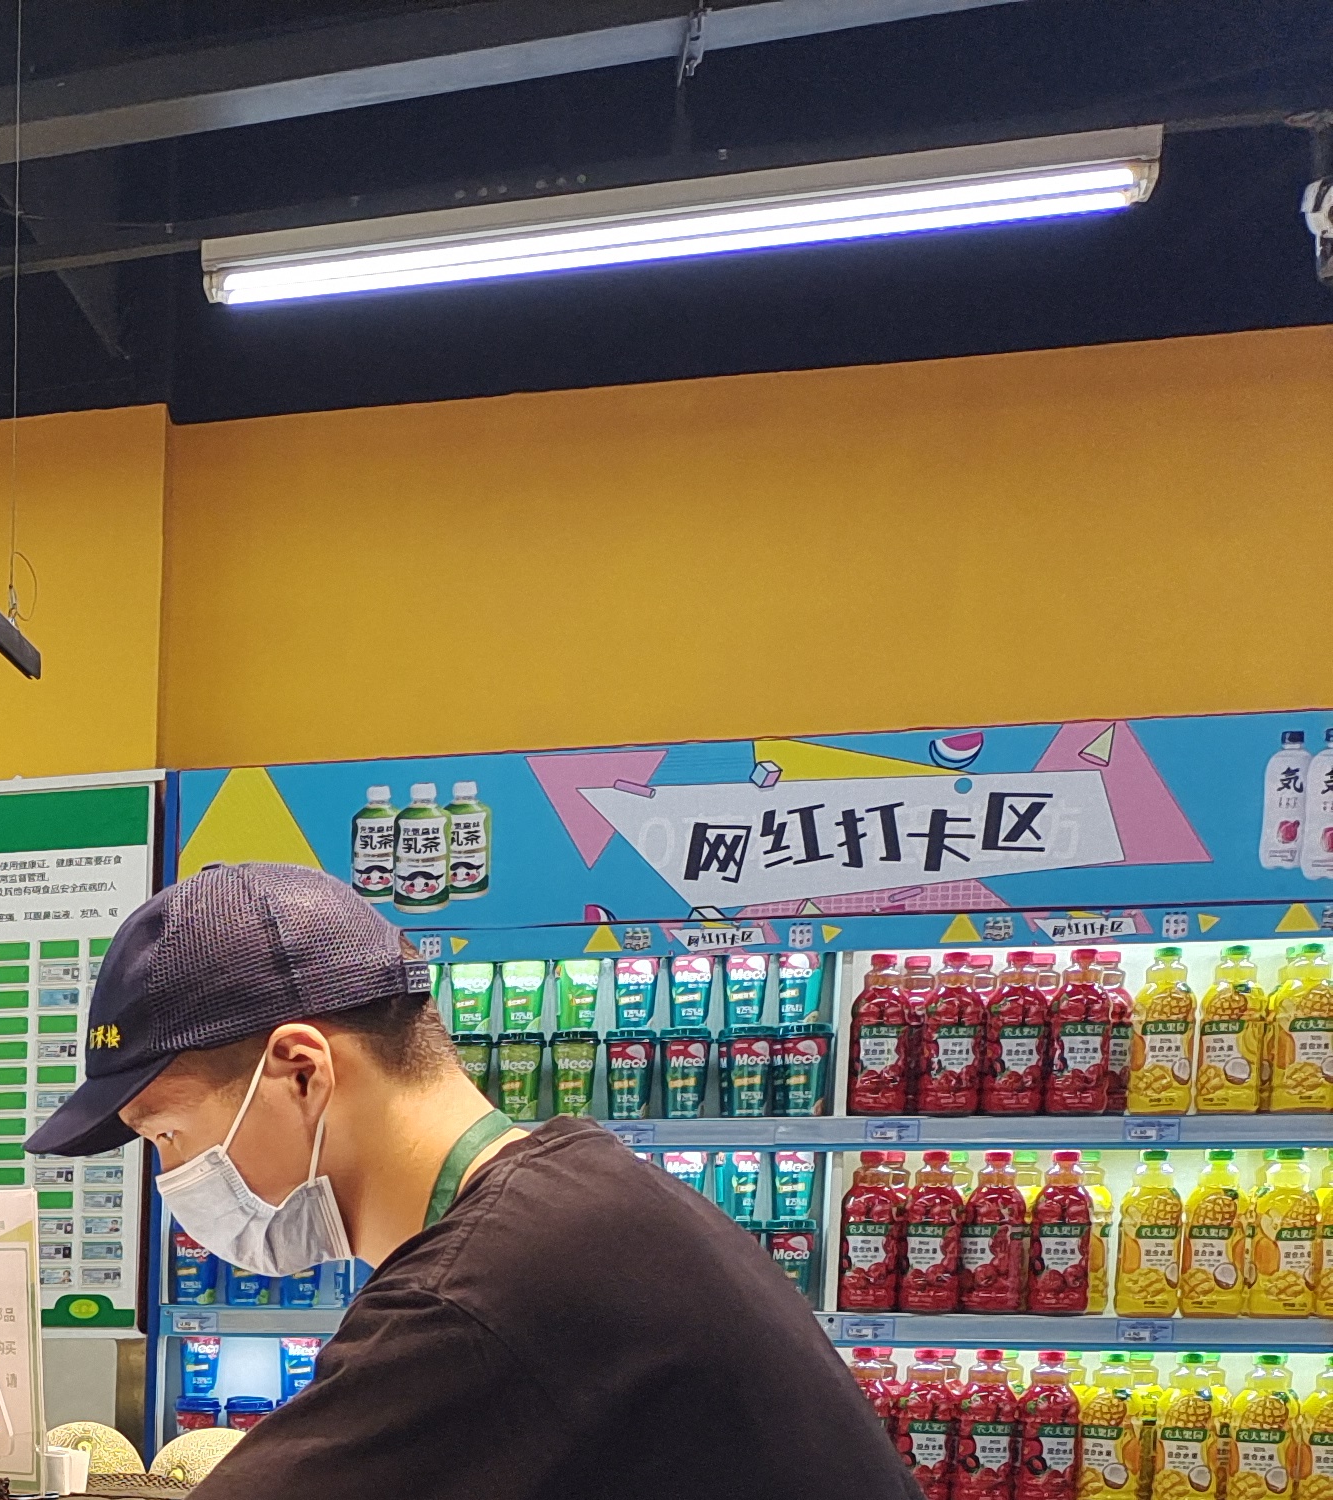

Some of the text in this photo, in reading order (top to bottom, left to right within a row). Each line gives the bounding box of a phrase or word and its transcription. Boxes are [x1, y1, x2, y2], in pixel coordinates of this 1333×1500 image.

[402, 837, 441, 854] 乳茶
[683, 792, 1053, 884] 网红打卡区
[1052, 920, 1123, 937] 网红打卡区
[686, 930, 754, 948] 网红打卡区
[618, 967, 654, 985] Meco
[675, 968, 711, 984] Meco
[730, 967, 766, 982] Meco
[500, 1058, 536, 1073] Meco
[557, 1057, 593, 1072] Meco
[611, 1056, 648, 1071] Meco
[670, 1055, 705, 1069] Meco
[735, 1053, 771, 1068] Meco
[784, 1052, 820, 1067] Meco
[773, 1248, 810, 1263] Meco
